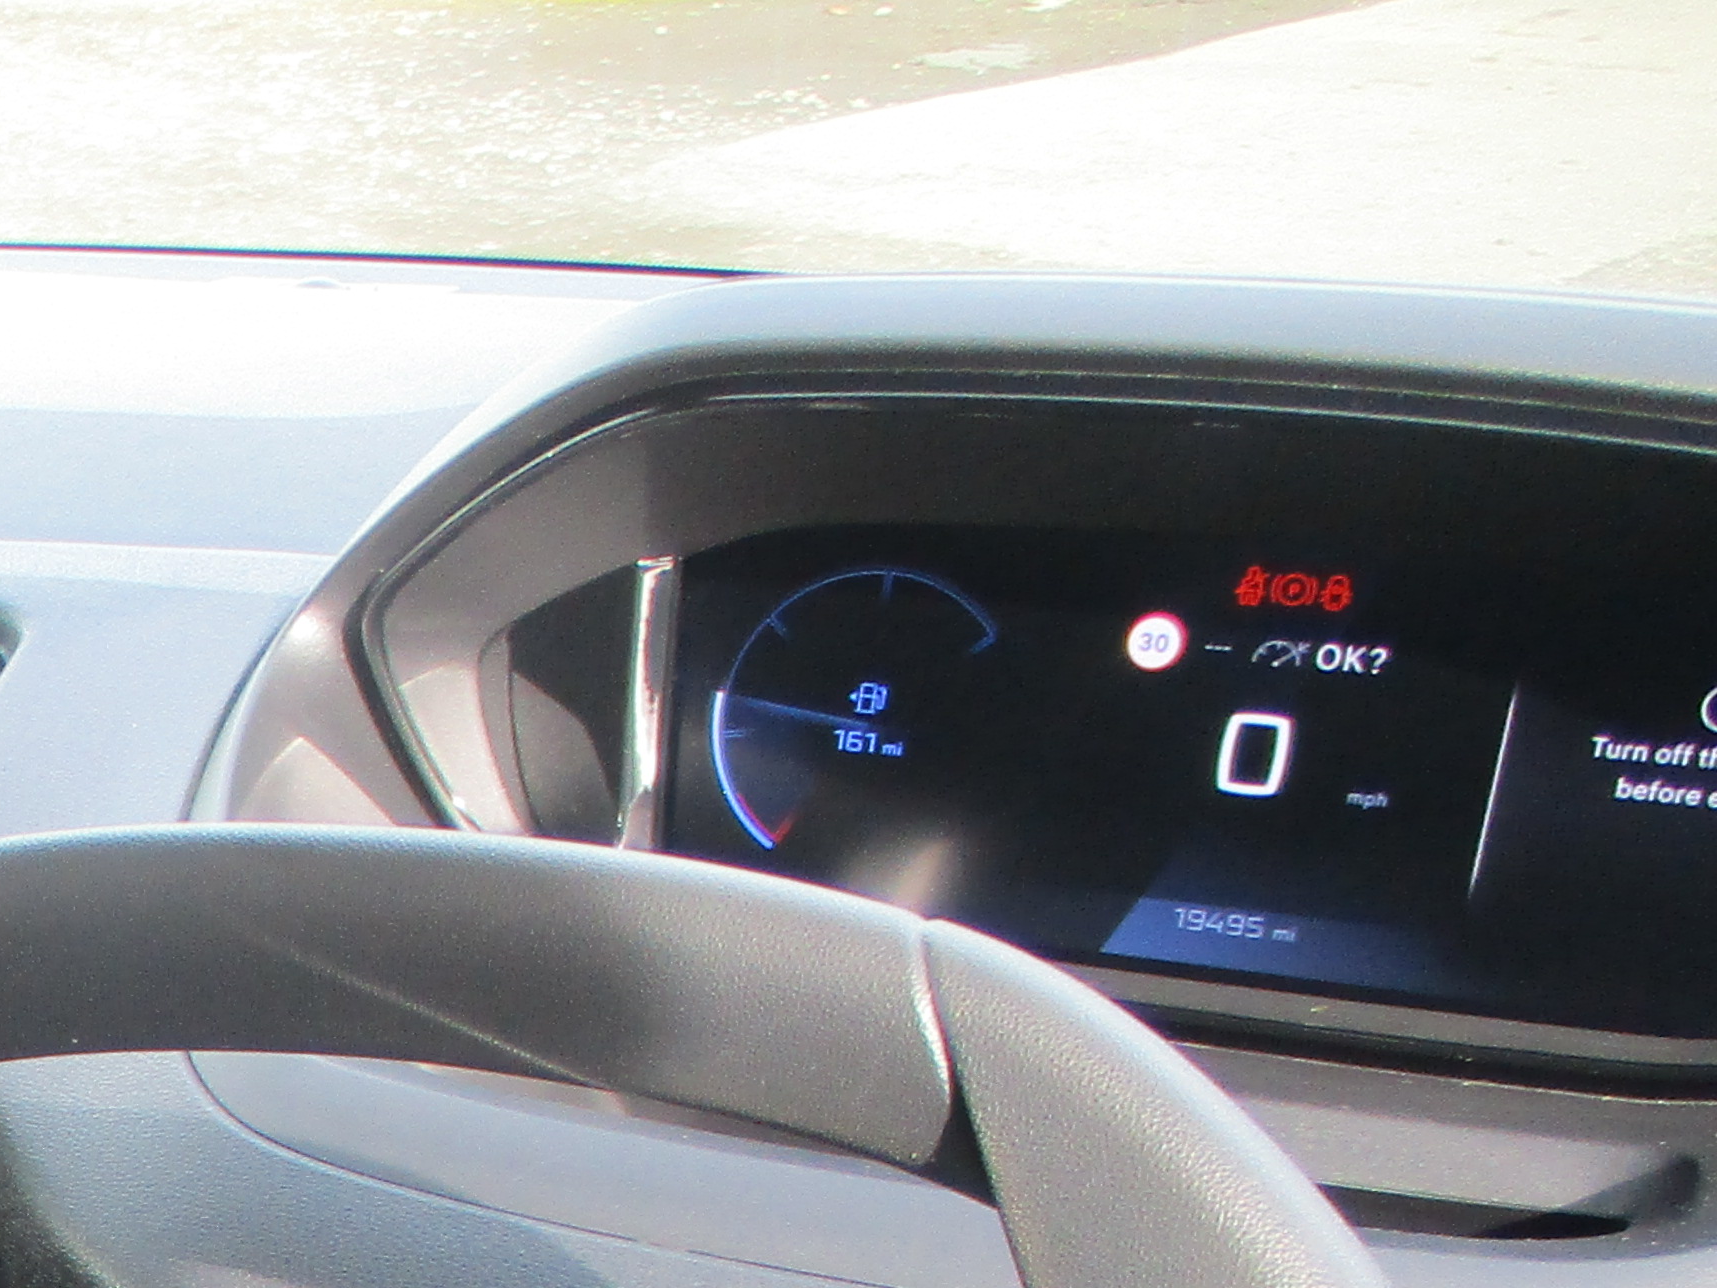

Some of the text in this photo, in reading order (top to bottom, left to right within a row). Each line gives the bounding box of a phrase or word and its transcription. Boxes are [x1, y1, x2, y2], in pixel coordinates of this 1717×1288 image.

[1138, 632, 1170, 654] 30
[1316, 642, 1390, 675] OK?
[833, 729, 904, 757] 161 mi
[1216, 711, 1295, 797] 0
[1591, 733, 1650, 763] Turn
[1654, 743, 1696, 767] off
[1346, 791, 1389, 811] mph
[1615, 775, 1703, 807] before
[1174, 907, 1264, 939] 19495
